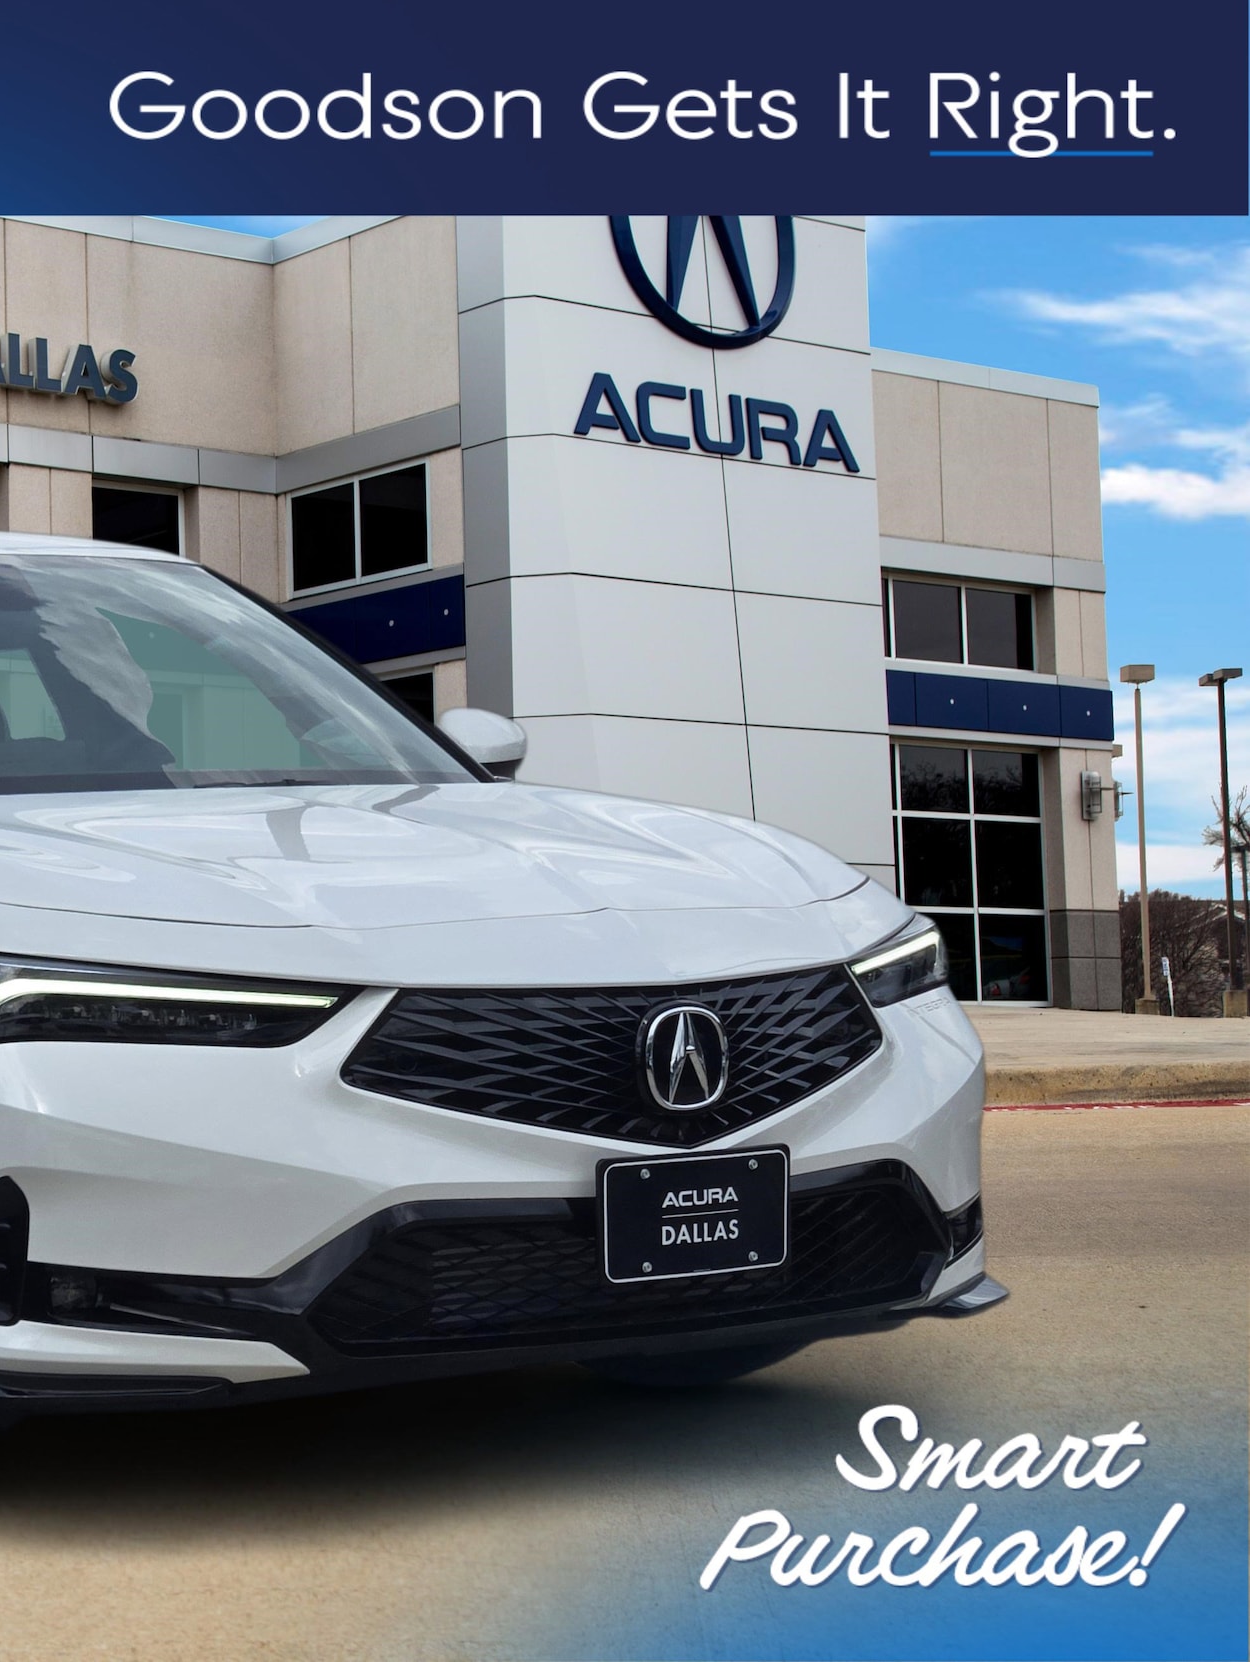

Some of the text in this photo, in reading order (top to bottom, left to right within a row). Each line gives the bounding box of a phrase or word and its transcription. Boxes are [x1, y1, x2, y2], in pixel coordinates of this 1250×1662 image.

[573, 372, 861, 474] ACURA
[661, 1186, 739, 1209] ACURA
[661, 1218, 739, 1246] DALLAS
